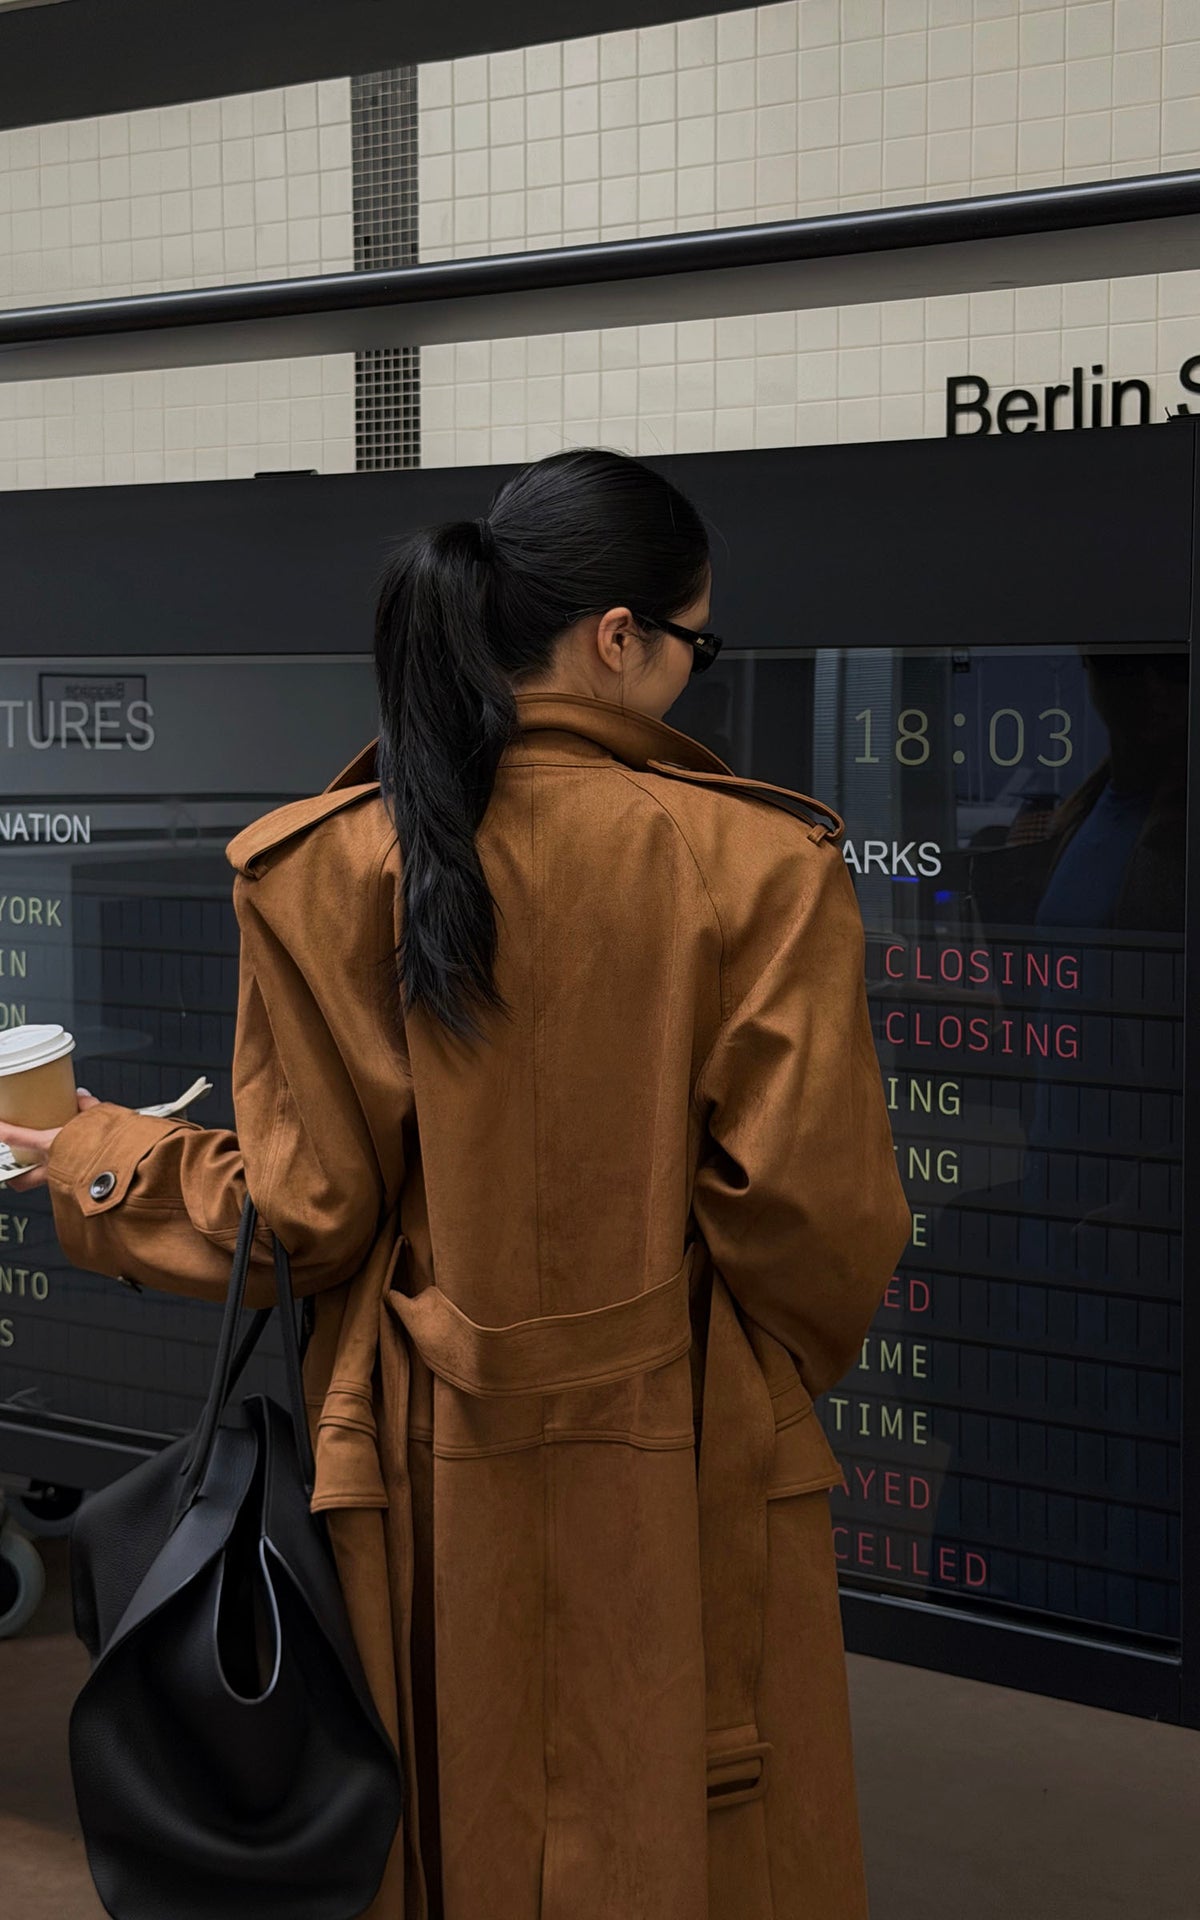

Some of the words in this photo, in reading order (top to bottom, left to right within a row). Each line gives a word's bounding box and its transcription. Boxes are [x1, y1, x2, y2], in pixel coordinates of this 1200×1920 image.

[946, 364, 1150, 434] Berlin
[0, 701, 155, 750] TURES
[854, 708, 1074, 767] 18:03
[842, 840, 942, 877] ARKS
[885, 945, 1079, 989] CLOSING
[885, 1011, 1078, 1058] CLOSING
[887, 1077, 960, 1115] ING
[893, 1145, 958, 1183] NG
[884, 1276, 930, 1312] ED
[859, 1338, 927, 1378] IME
[829, 1398, 927, 1444] TIME
[832, 1527, 987, 1587] CELLED
